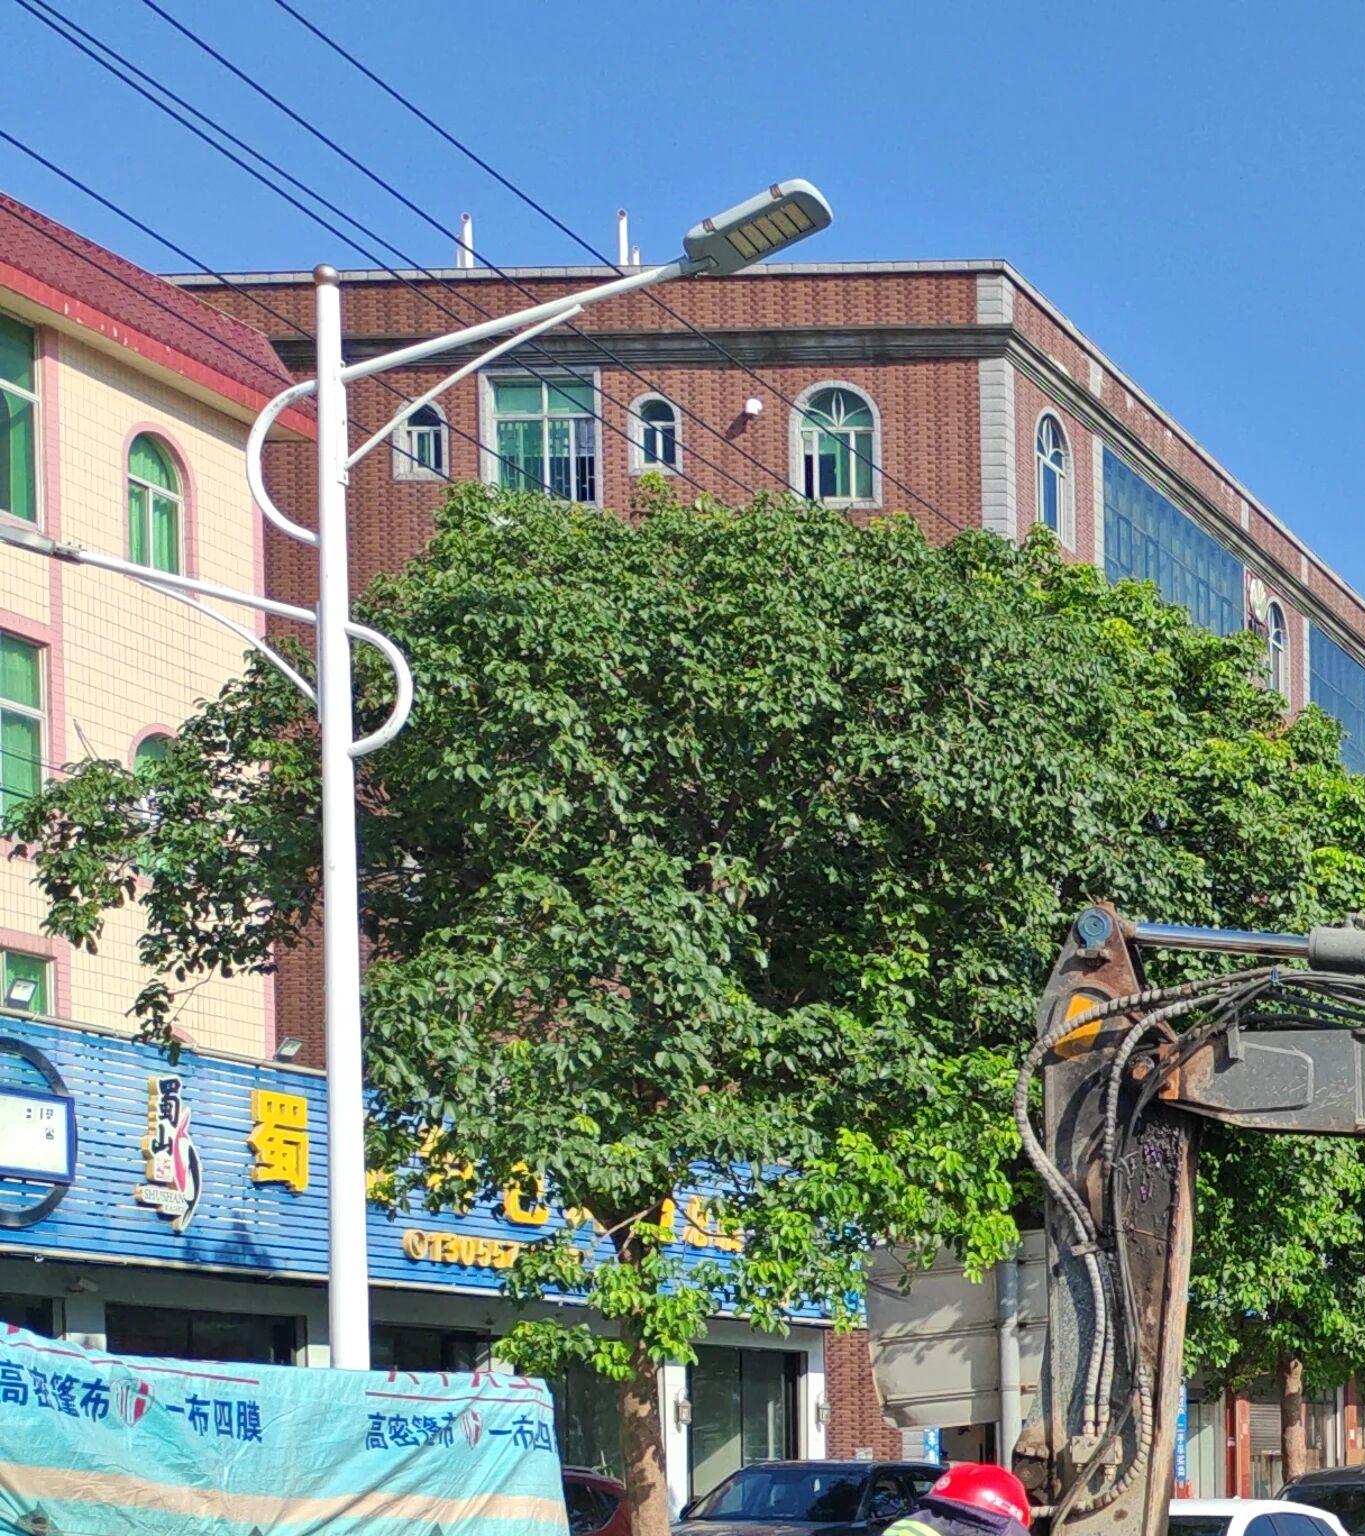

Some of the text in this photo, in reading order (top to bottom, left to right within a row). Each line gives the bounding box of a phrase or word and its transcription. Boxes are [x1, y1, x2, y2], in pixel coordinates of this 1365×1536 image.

[151, 1078, 181, 1156] 蜀山
[144, 1188, 186, 1204] SHUSHAN
[0, 1360, 262, 1443] 高密篷布 一布四膜
[489, 1415, 556, 1453] 一布四
